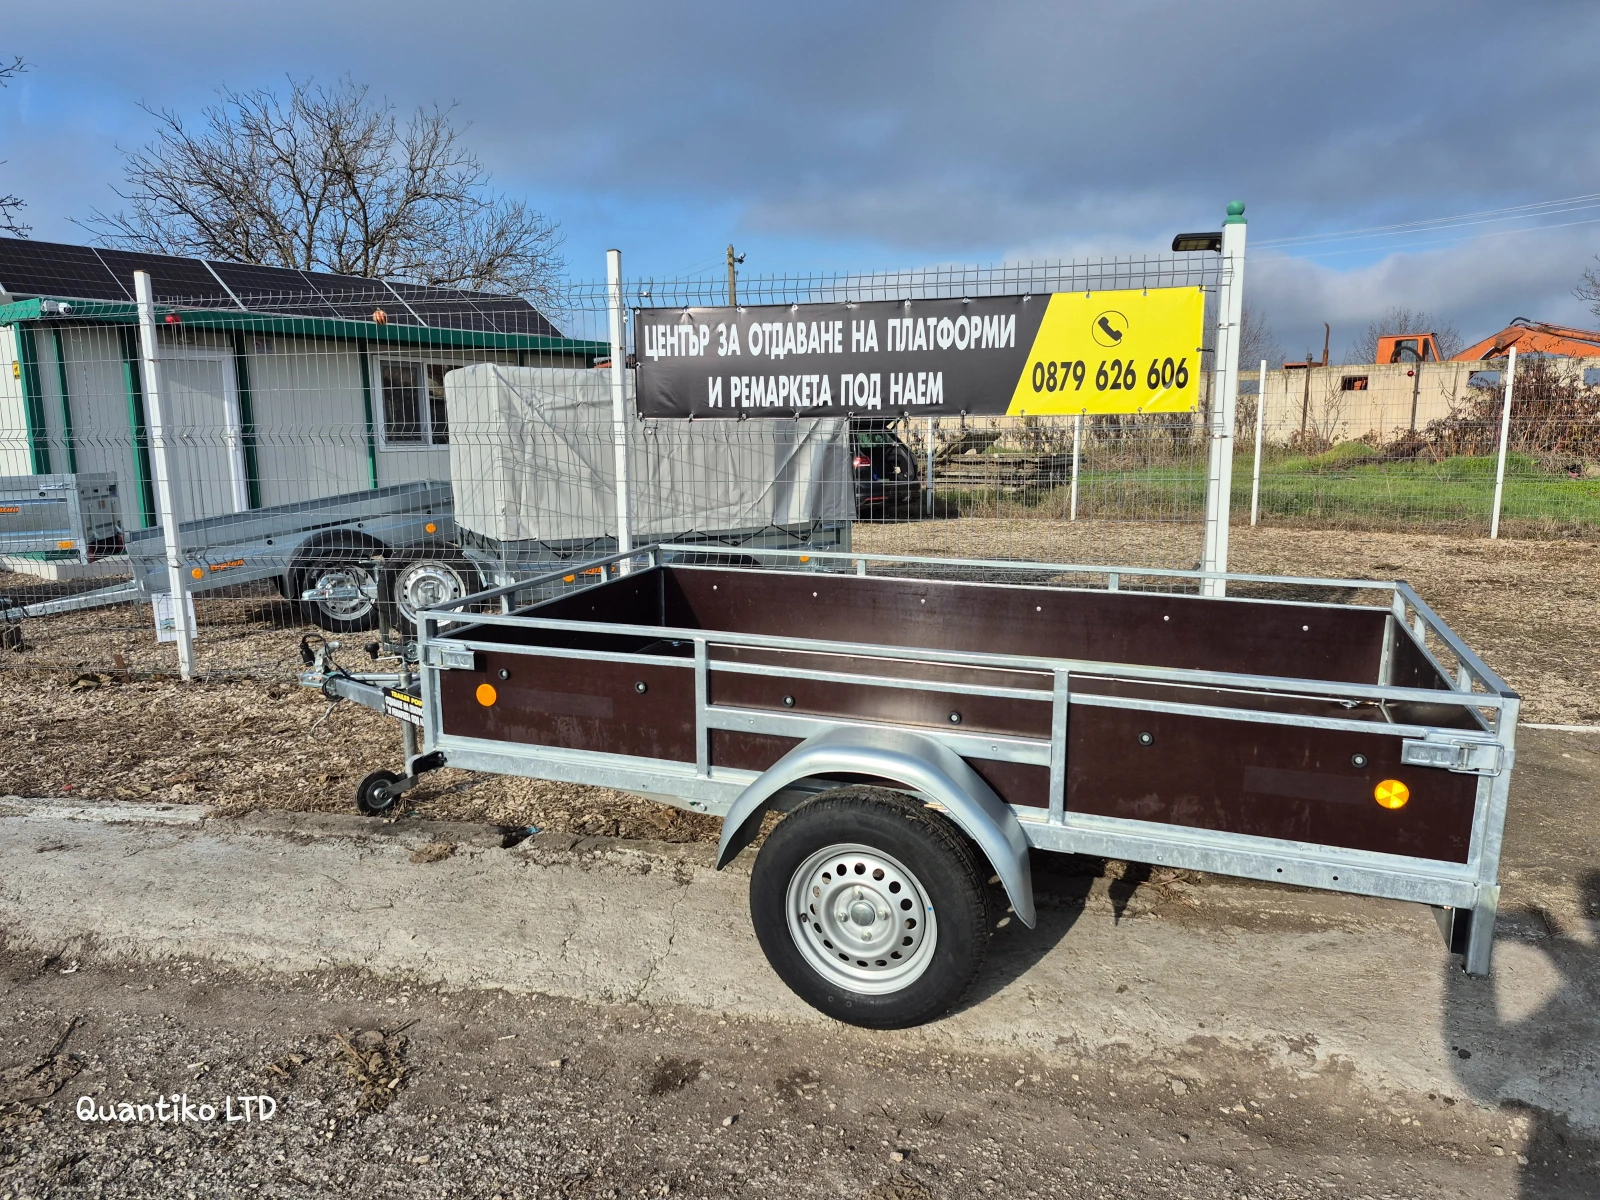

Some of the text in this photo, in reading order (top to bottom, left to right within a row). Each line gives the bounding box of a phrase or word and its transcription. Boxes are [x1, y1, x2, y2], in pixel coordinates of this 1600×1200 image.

[644, 314, 1016, 361] ЦЕНТЪР ЗА ОТДАВАНЕ НА ПЛАТФОРМИ
[708, 371, 944, 410] И РЕМАРКЕТА ПОД НАЕМ
[1032, 357, 1189, 393] 0879 626 606
